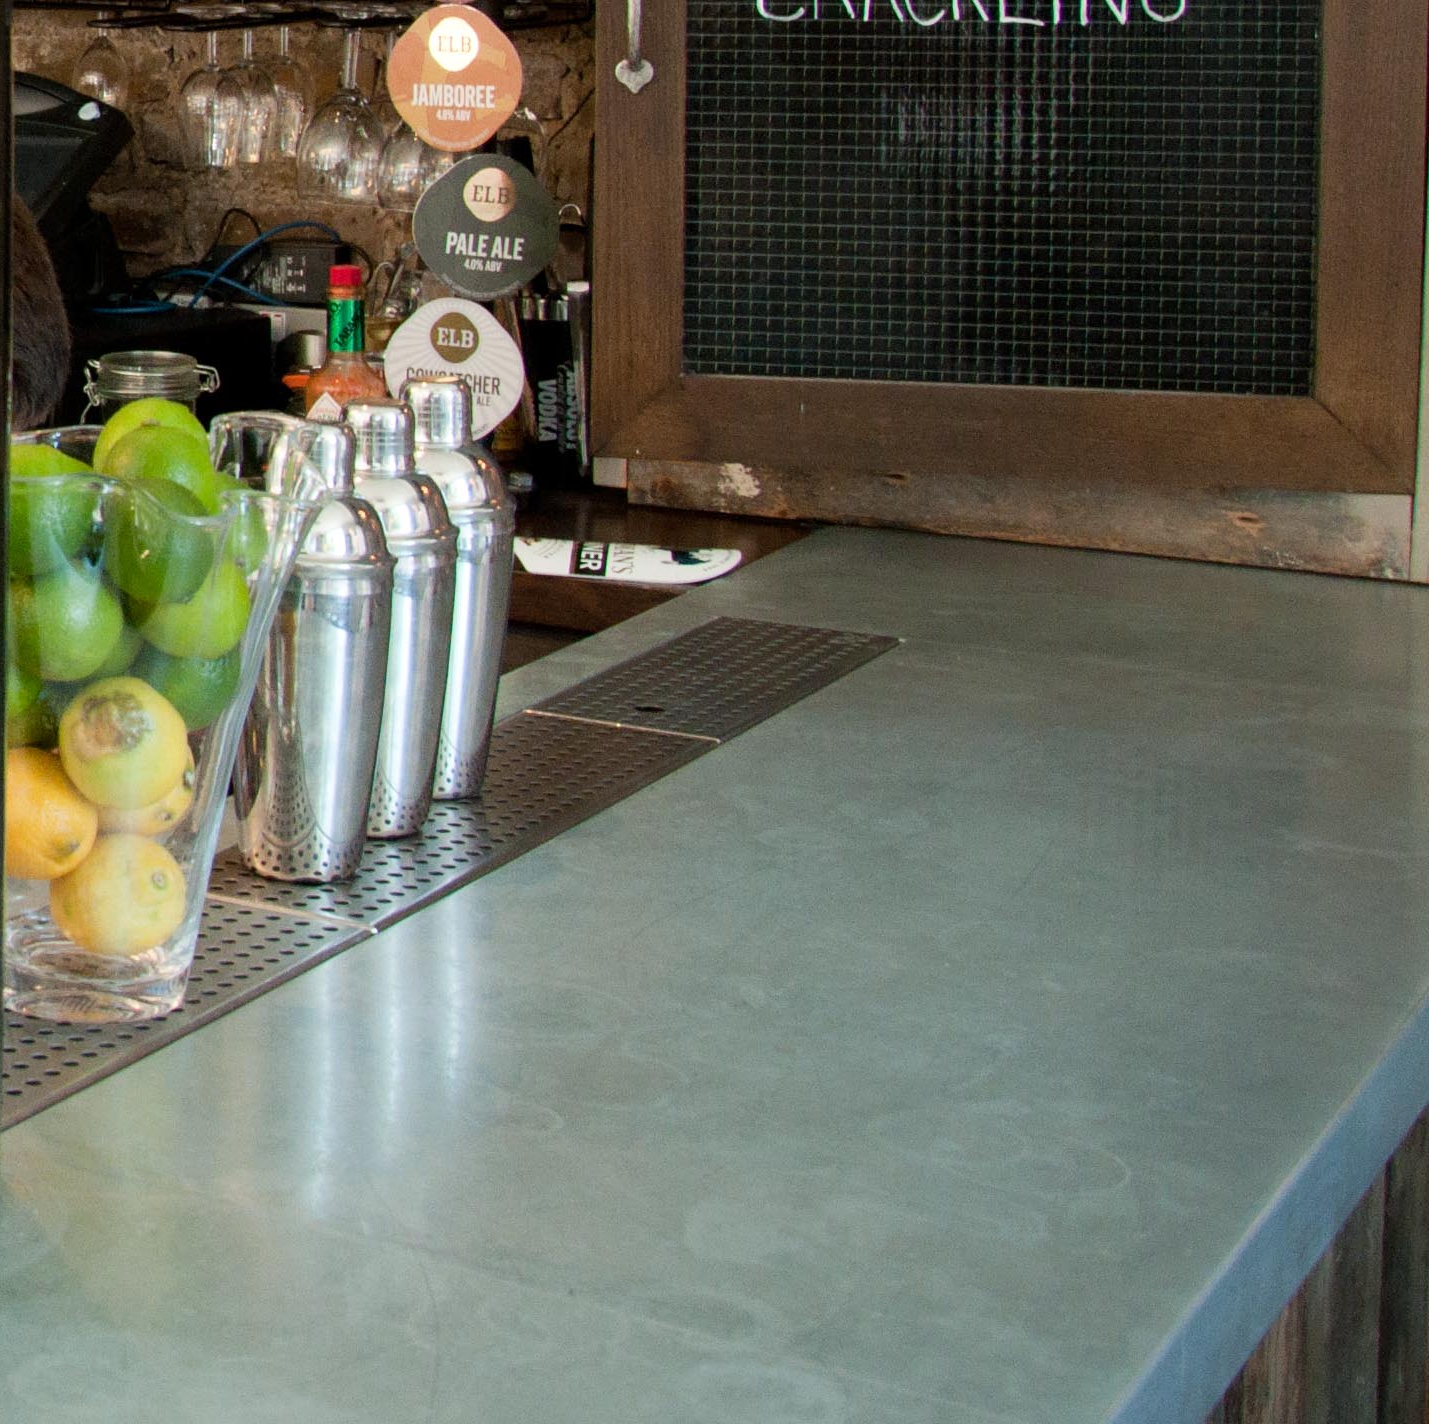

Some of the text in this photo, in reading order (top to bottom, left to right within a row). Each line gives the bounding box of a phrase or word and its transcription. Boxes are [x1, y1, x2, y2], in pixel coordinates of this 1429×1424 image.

[437, 35, 472, 53] ELB
[411, 83, 496, 108] JAMBOREE
[472, 185, 510, 204] ELB
[445, 232, 525, 261] PALE ALE
[436, 327, 475, 348] ELB
[538, 379, 558, 442] VODKA
